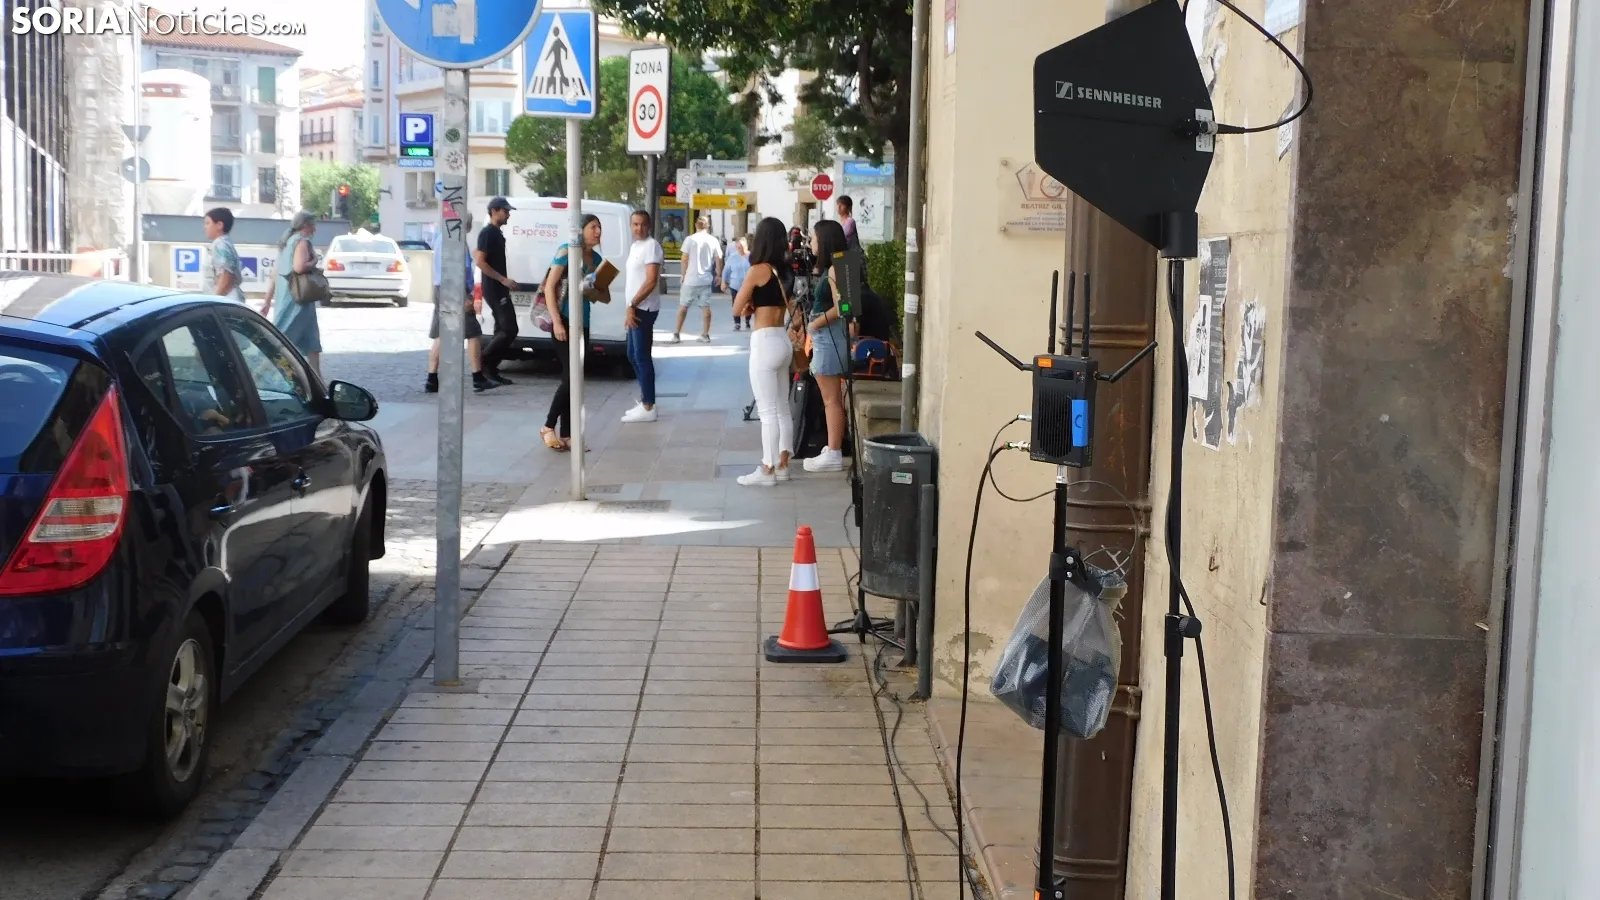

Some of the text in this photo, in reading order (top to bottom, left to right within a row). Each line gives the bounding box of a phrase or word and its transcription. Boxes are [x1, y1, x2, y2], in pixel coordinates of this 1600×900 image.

[635, 61, 663, 75] ZONA
[1077, 86, 1162, 109] SENNHEISER
[639, 103, 656, 120] 30
[405, 117, 427, 142] P
[813, 183, 833, 192] STOP
[512, 225, 558, 238] Express
[178, 249, 197, 271] P
